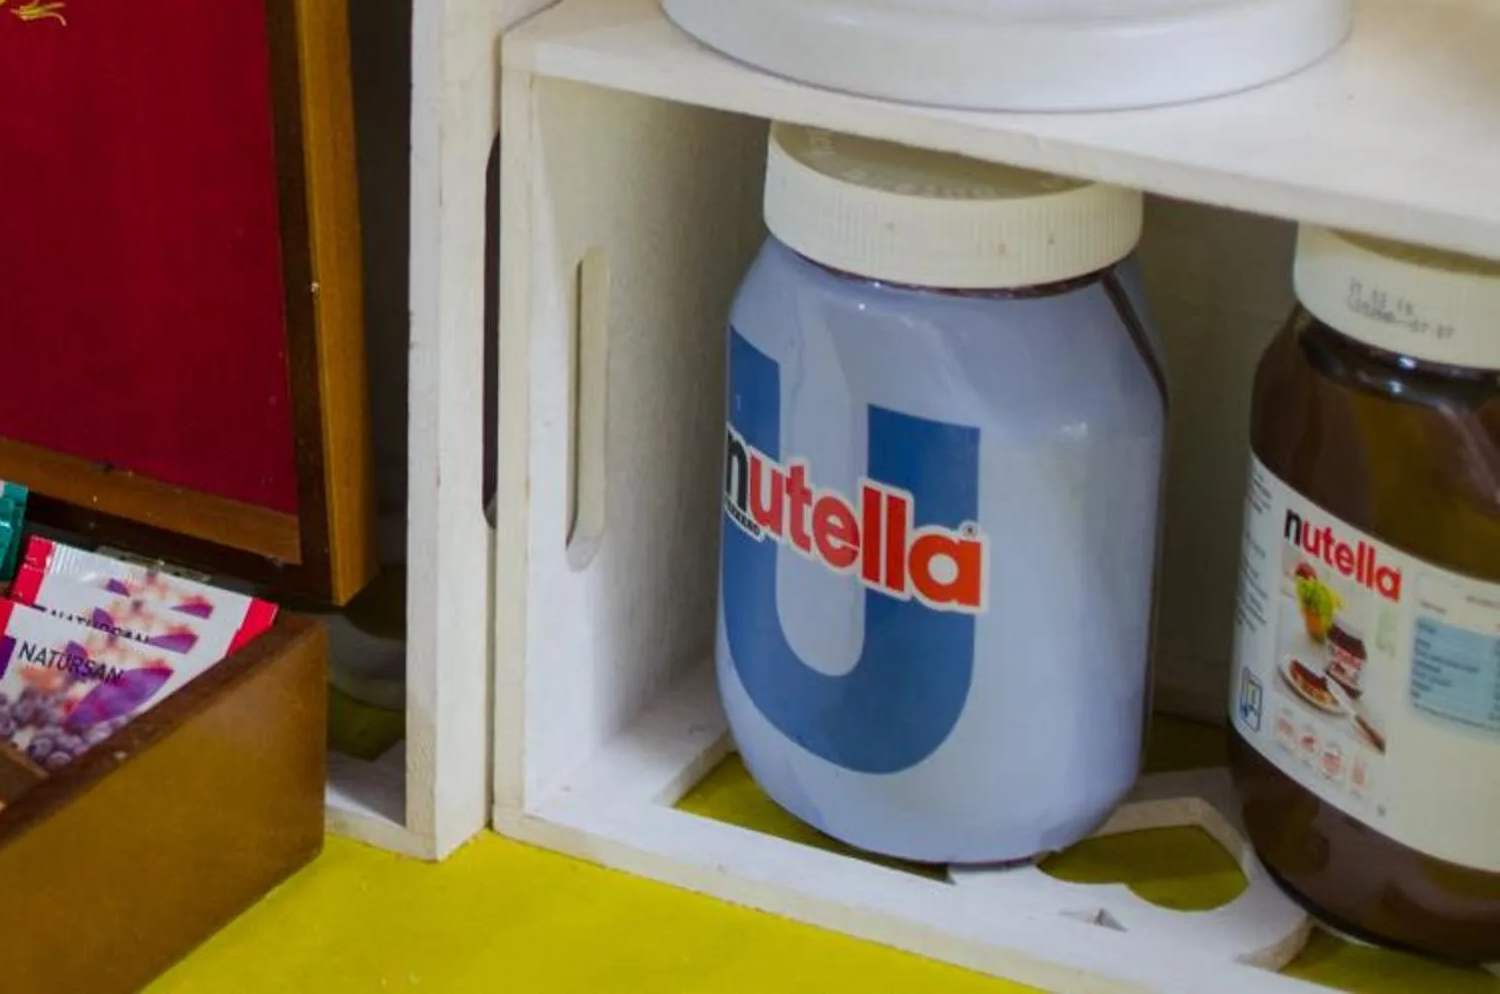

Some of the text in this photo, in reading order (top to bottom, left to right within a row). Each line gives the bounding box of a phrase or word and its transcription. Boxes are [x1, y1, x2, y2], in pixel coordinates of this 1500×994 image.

[726, 434, 982, 608] nutella
[1284, 508, 1402, 602] nutella
[18, 641, 125, 684] NATURSAN
